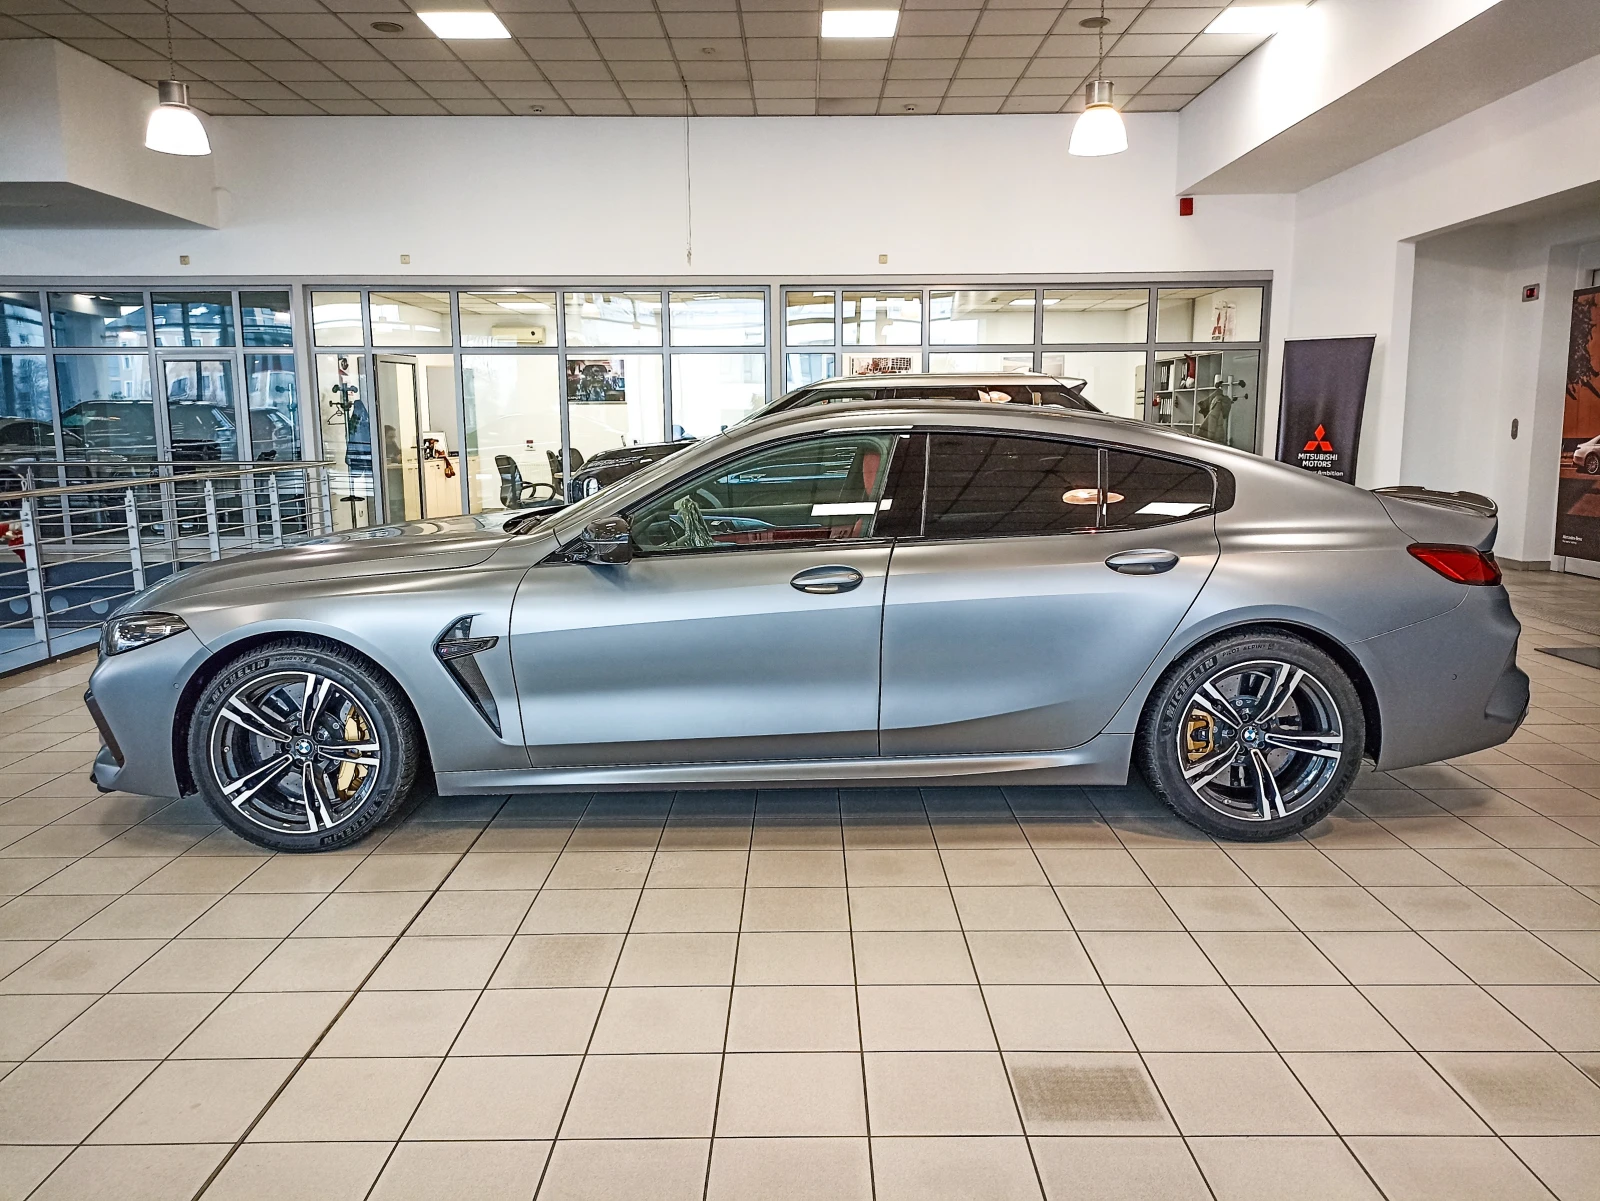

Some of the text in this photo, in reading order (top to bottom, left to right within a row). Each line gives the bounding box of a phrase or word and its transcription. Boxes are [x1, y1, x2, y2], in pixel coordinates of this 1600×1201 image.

[1302, 460, 1332, 468] MOTORS
[211, 659, 268, 702] MICHELIN
[1166, 658, 1215, 718] MICHELIN
[324, 803, 378, 844] MICHELIN
